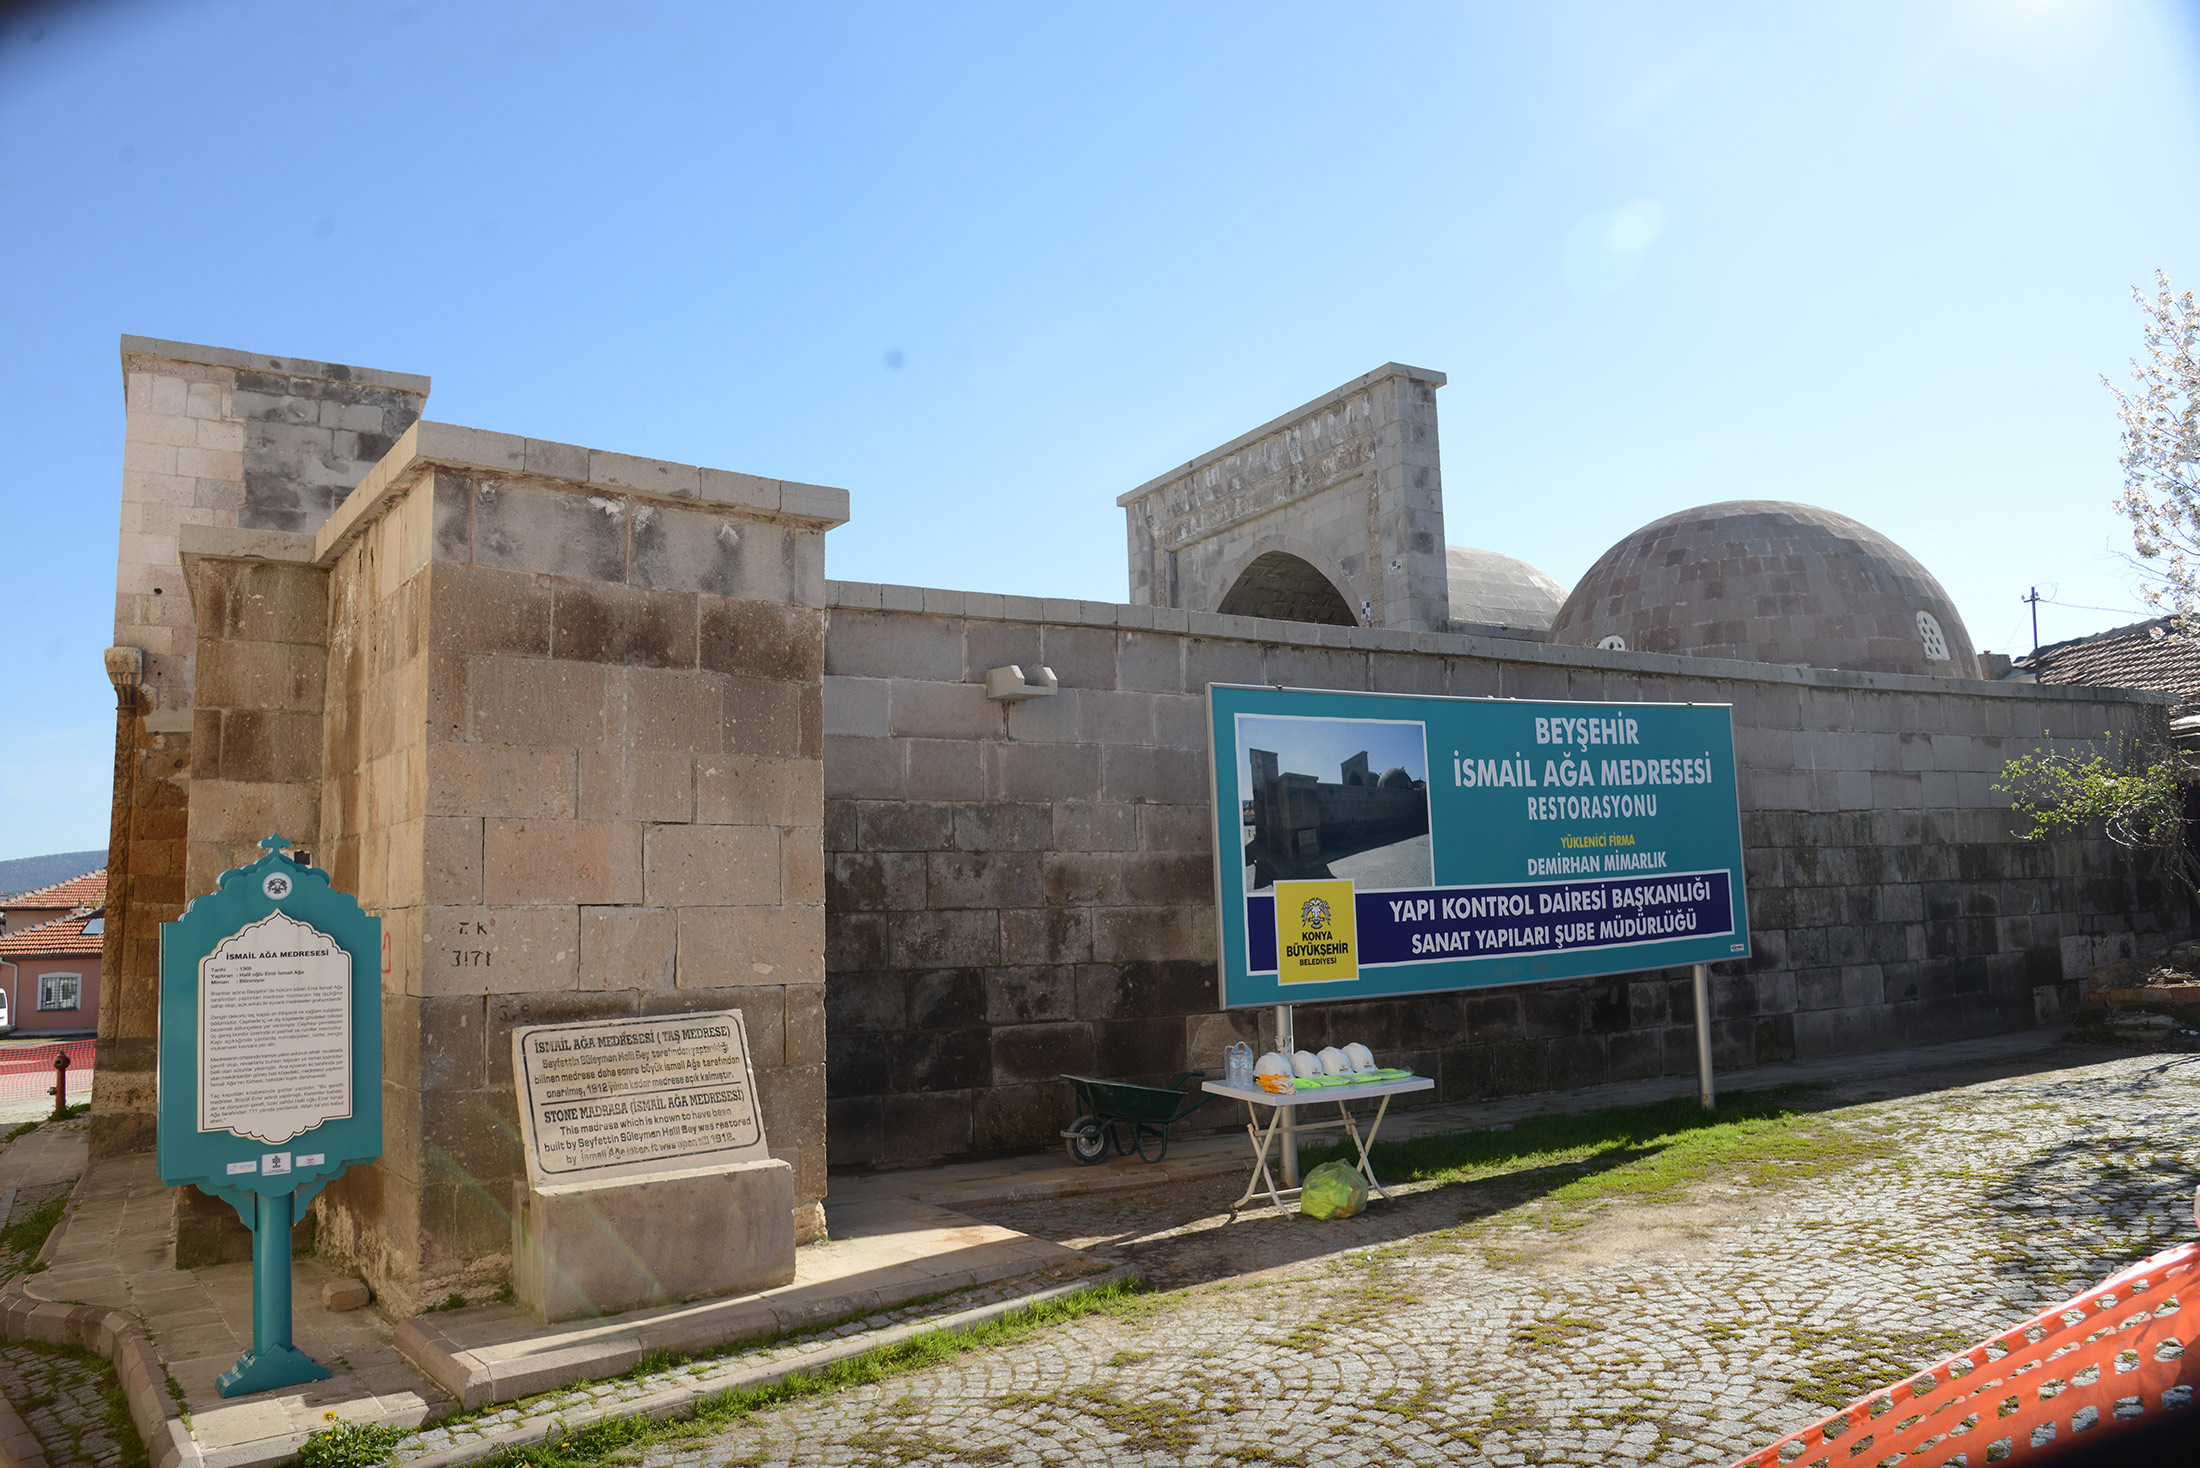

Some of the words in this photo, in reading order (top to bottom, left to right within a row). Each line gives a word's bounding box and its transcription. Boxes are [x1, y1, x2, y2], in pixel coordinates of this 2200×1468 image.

[1535, 711, 1639, 752] BEYŞEHİR
[1454, 750, 1536, 787] İSMAİL
[1543, 752, 1595, 787] AĞA
[1601, 751, 1712, 786] MEDRESESİ
[1528, 794, 1657, 820] RESTORASYONU
[1561, 832, 1607, 848] YÜKLENİCİ
[1608, 832, 1635, 847] FİRMA
[1528, 852, 1600, 876] DEMİRHAN
[1604, 850, 1667, 871] MİMARLIK
[1389, 899, 1435, 922] YAPI
[1442, 894, 1534, 919] KONTROL
[1539, 884, 1607, 914] DAİRESİ
[1612, 876, 1711, 912] BAŞKANLIĞI
[1302, 931, 1333, 941] KONYA
[1411, 930, 1471, 955] SANAT
[1474, 925, 1549, 949] YAPILARI
[1554, 922, 1595, 949] ŞUBE
[1600, 908, 1697, 939] MÜDÜRLÜĞÜ
[226, 952, 256, 960] İSMAİL
[259, 951, 277, 959] AĞA
[280, 948, 329, 958] MEDRESESİ
[1286, 940, 1349, 957] BÜYÜKŞEHİR
[1300, 956, 1337, 966] BELEDİYESİ
[534, 1038, 572, 1053] İSMAİL
[574, 1035, 596, 1050] AĞA
[597, 1030, 655, 1047] MEDRESESİ
[662, 1030, 680, 1044] TAŞ
[682, 1026, 730, 1040] MEDRESE)
[534, 1074, 560, 1085] bilinen
[561, 1071, 595, 1081] medrese
[597, 1068, 616, 1078] daha
[617, 1067, 639, 1076] sonra
[641, 1062, 663, 1074] büyük
[686, 1059, 701, 1070] Ağa
[702, 1056, 740, 1067] tarafından
[542, 1057, 579, 1070] Seyfettin
[580, 1055, 617, 1066] Süleyman
[635, 1050, 649, 1061] Bey
[651, 1047, 690, 1058] tarafından
[546, 1087, 586, 1098] onarılmış,
[586, 1082, 608, 1094] 1912
[629, 1079, 651, 1089] kadar
[652, 1077, 684, 1086] medrese
[685, 1073, 700, 1085] açık
[700, 1071, 734, 1082] kalmıştır.
[544, 1108, 578, 1123] STONE
[579, 1103, 628, 1119] MADRASA
[630, 1096, 667, 1115] (İSMAİL
[668, 1093, 689, 1109] AĞA
[689, 1087, 744, 1106] MEDRESESİ)
[544, 1141, 565, 1152] built
[565, 1140, 577, 1151] by
[578, 1134, 619, 1149] Seyfettin
[620, 1130, 661, 1142] Süleyman
[662, 1126, 680, 1137] Halil
[681, 1125, 697, 1135] Bey
[698, 1123, 715, 1132] was
[715, 1116, 751, 1129] restored
[559, 1125, 579, 1135] This
[580, 1122, 619, 1133] madrasa
[620, 1117, 645, 1128] which
[645, 1116, 653, 1125] is
[653, 1114, 681, 1124] known
[681, 1113, 691, 1121] to
[692, 1111, 711, 1119] have
[712, 1108, 731, 1117] been
[566, 1150, 576, 1166] by
[711, 1132, 735, 1143] 1912.
